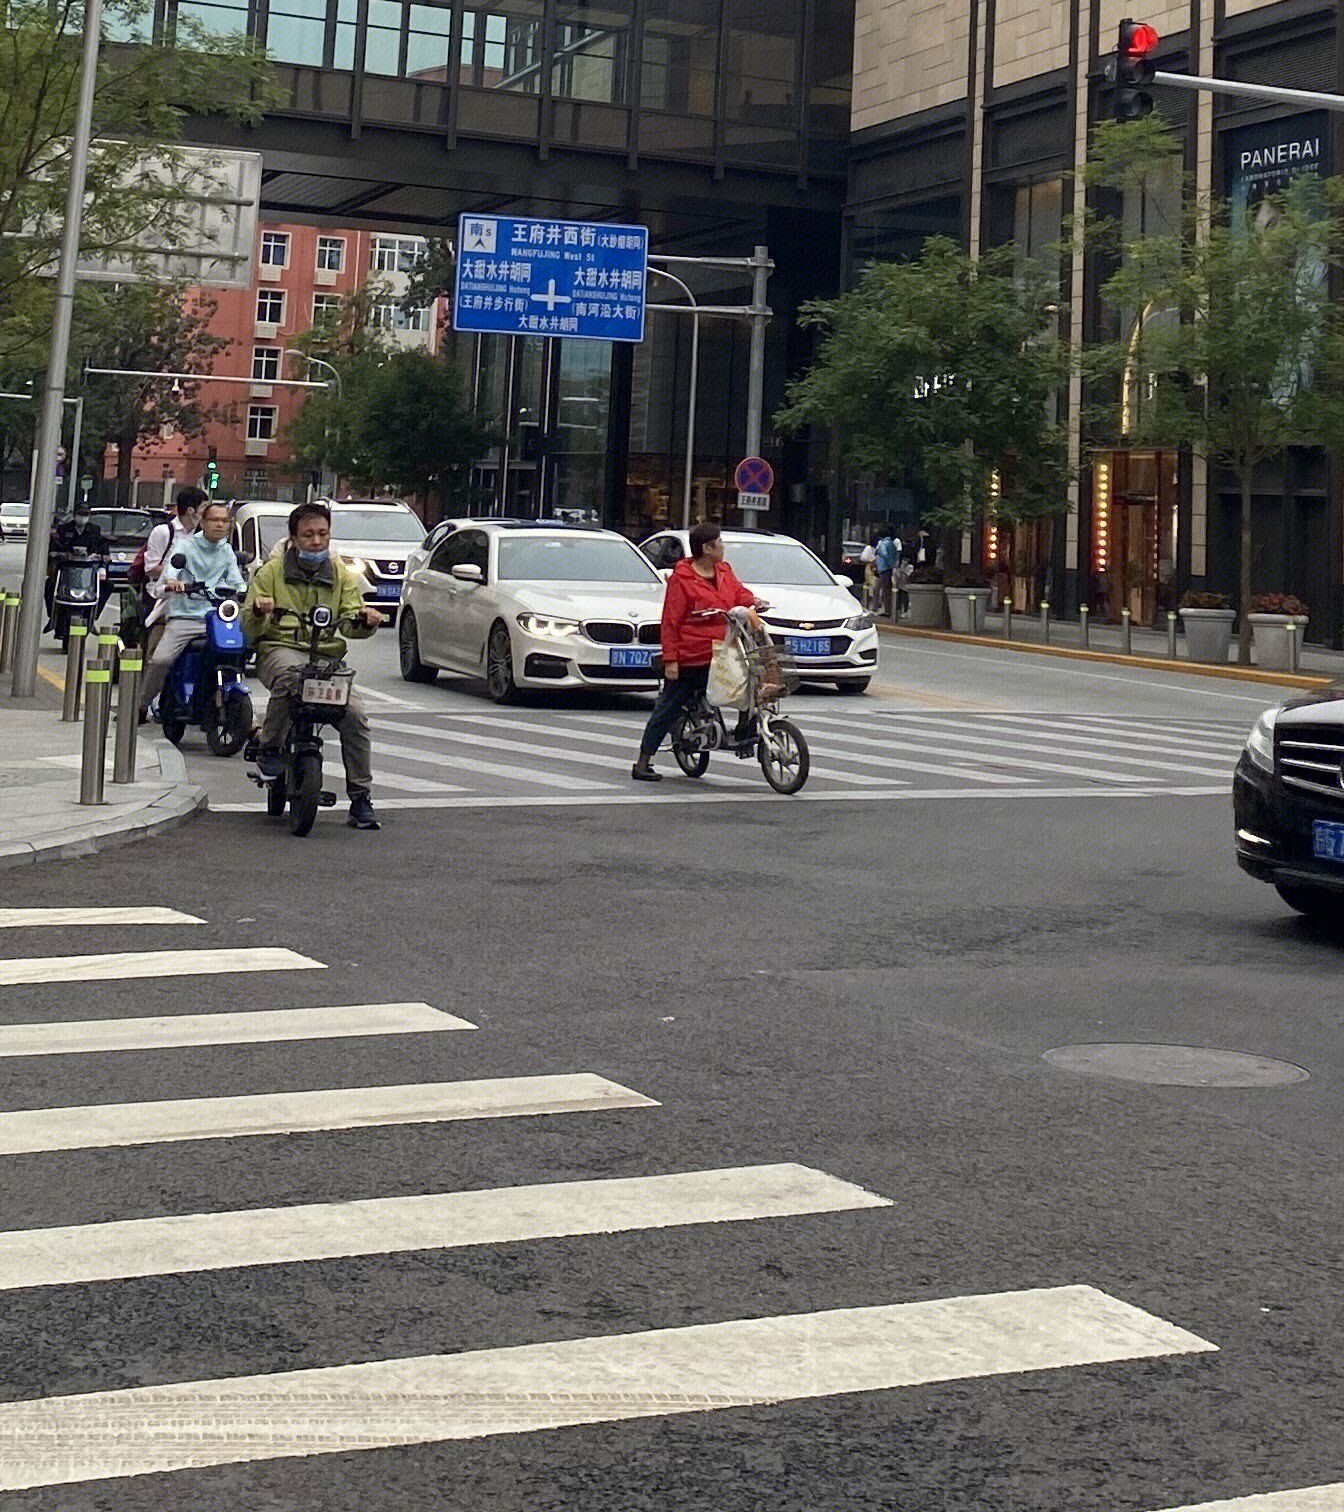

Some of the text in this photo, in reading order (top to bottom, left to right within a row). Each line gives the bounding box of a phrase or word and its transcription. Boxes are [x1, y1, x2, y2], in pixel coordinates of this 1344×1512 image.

[1240, 137, 1320, 170] PANERAI
[470, 223, 492, 237] 南 S
[512, 224, 596, 247] 王府井西街
[511, 248, 595, 263] WANGFUJING West St
[461, 258, 532, 283] 大甜水井胡同
[574, 266, 643, 291] 大甜水井胡同
